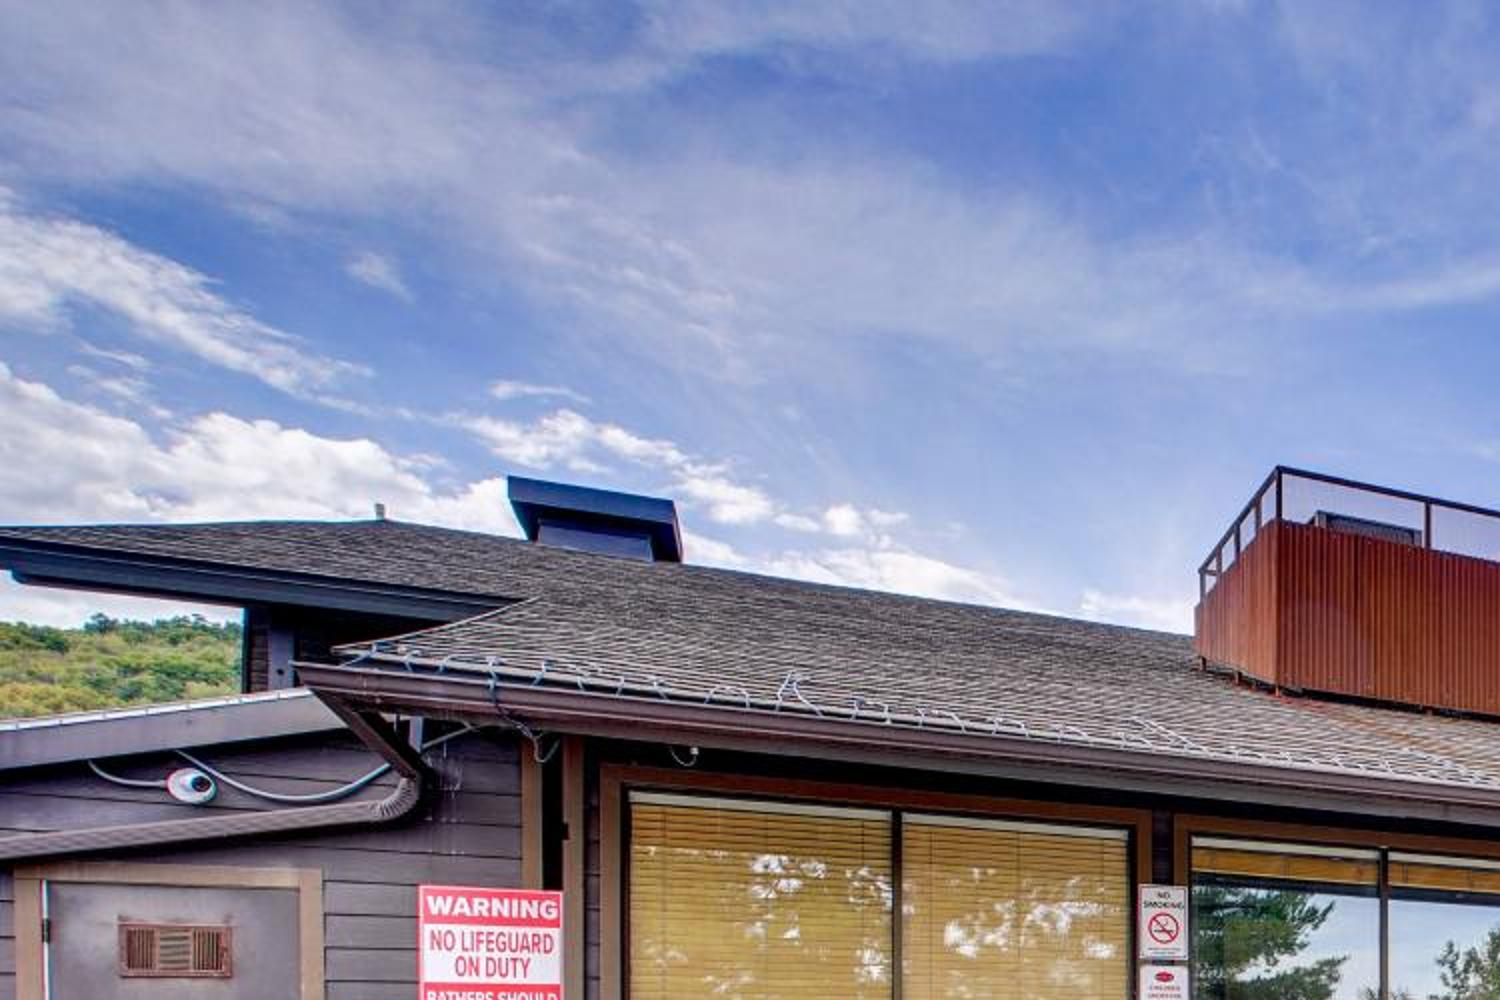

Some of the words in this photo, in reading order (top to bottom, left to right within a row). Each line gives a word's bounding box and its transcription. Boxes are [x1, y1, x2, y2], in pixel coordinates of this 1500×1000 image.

[426, 895, 559, 920] WARNING
[429, 929, 456, 951] NO
[461, 930, 554, 954] LIFEGUARD
[454, 955, 480, 977] ON
[485, 956, 531, 979] DUTY
